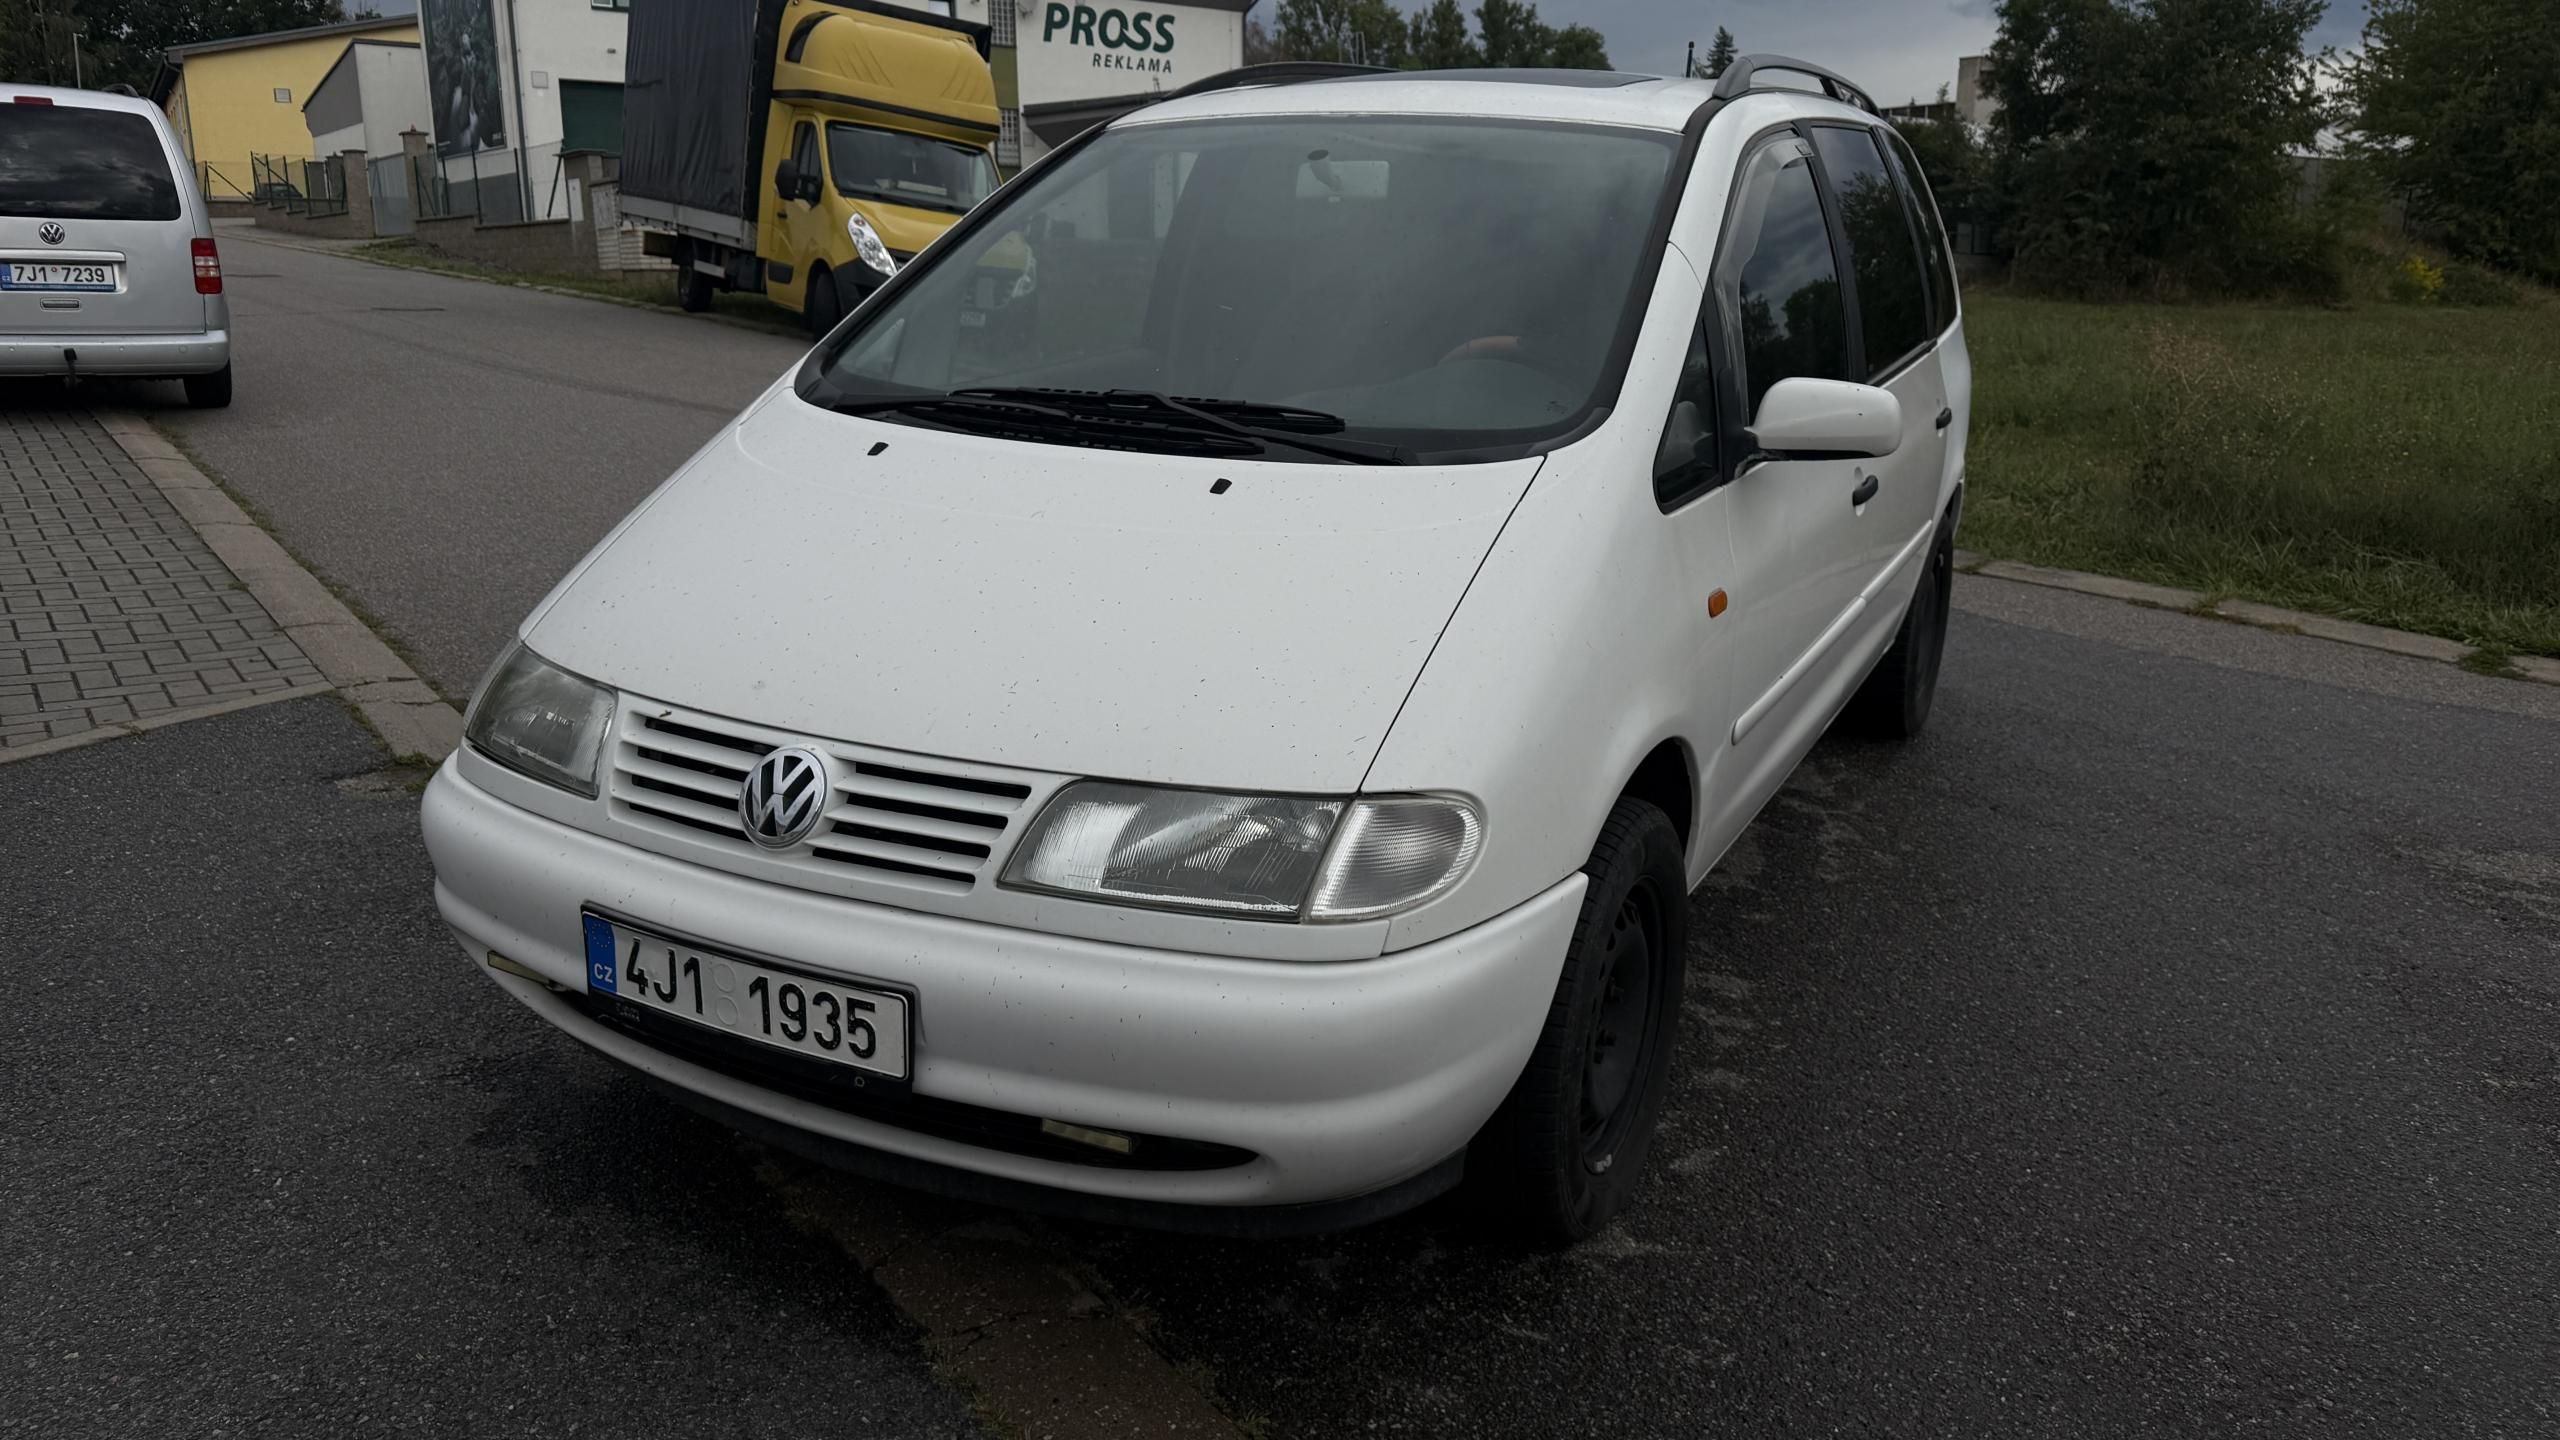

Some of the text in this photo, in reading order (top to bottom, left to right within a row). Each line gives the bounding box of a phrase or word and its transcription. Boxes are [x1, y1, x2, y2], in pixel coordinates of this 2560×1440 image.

[1043, 3, 1175, 53] PROSS
[1093, 53, 1172, 73] REKLAMA
[14, 266, 48, 281] 7J1
[61, 267, 105, 282] 7239
[594, 938, 876, 1058] CZ 4J1 1935
